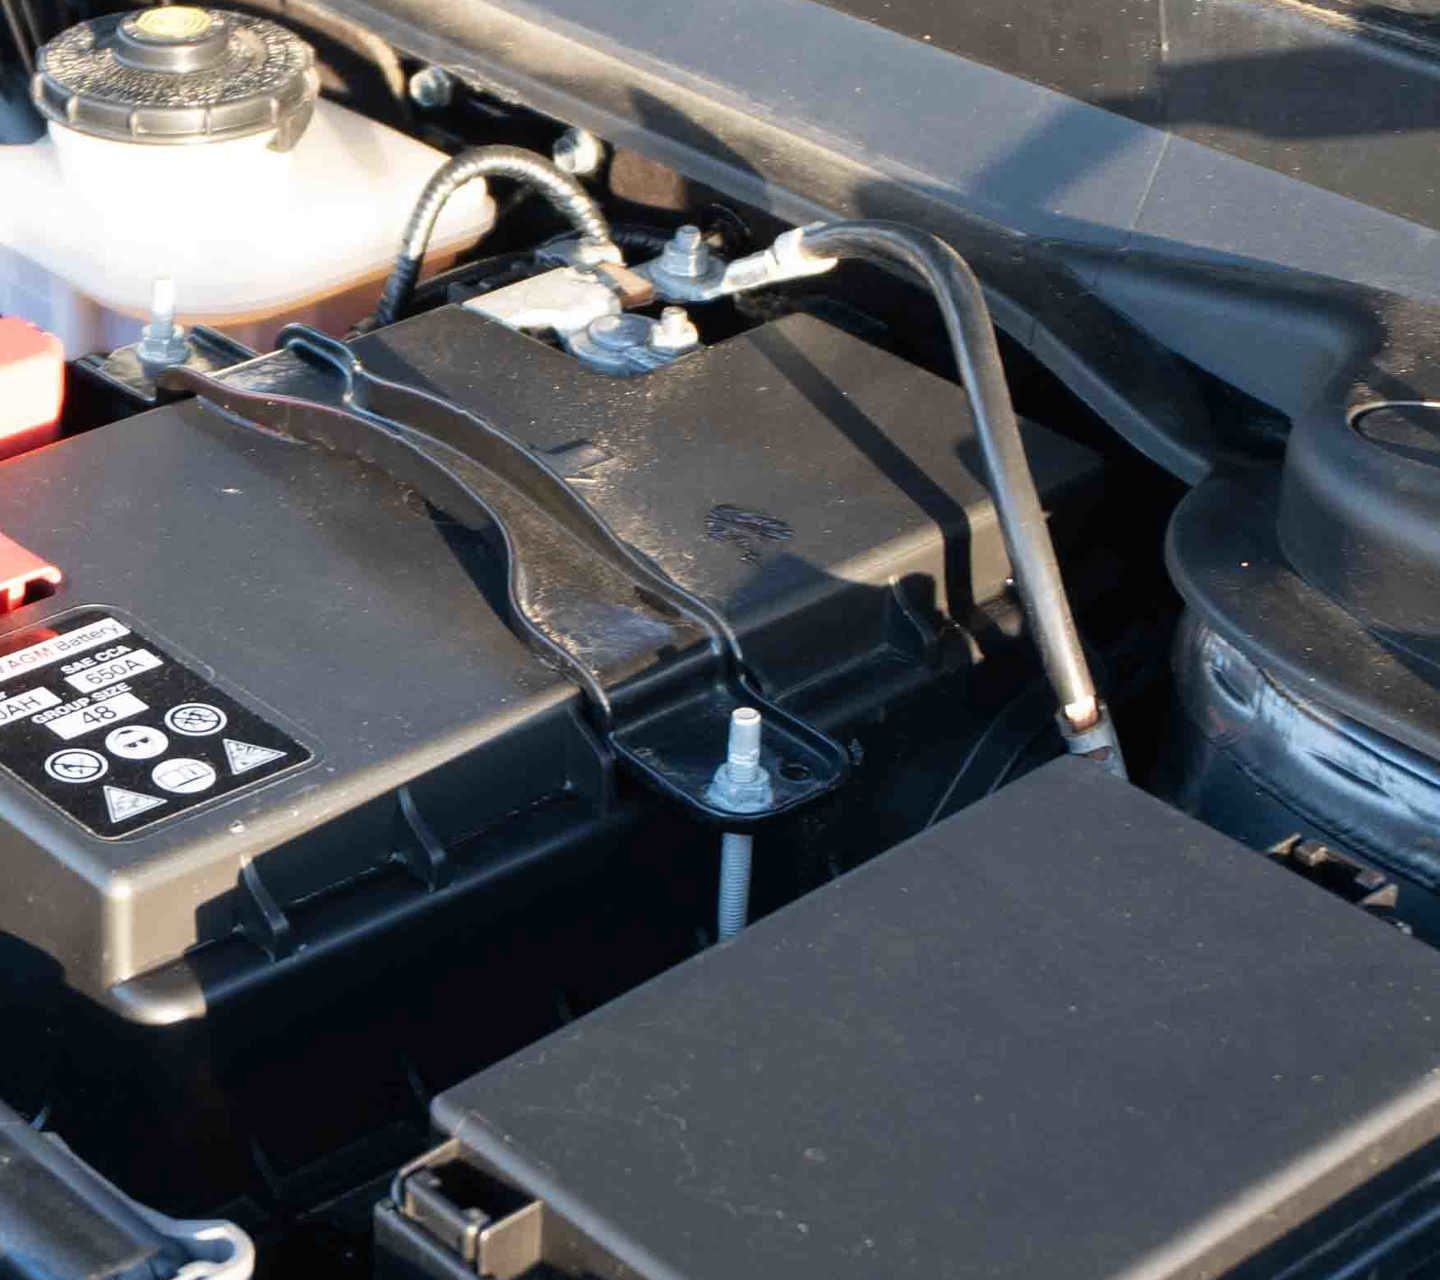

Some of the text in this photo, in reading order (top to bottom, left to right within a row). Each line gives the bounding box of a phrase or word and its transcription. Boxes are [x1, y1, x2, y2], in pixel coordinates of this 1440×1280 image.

[7, 646, 54, 671] AGM
[55, 624, 119, 651] Battery
[60, 645, 132, 675] SAE CCA
[86, 659, 145, 685] 650A
[31, 681, 133, 724] GROUP SIZE
[82, 705, 118, 725] 48
